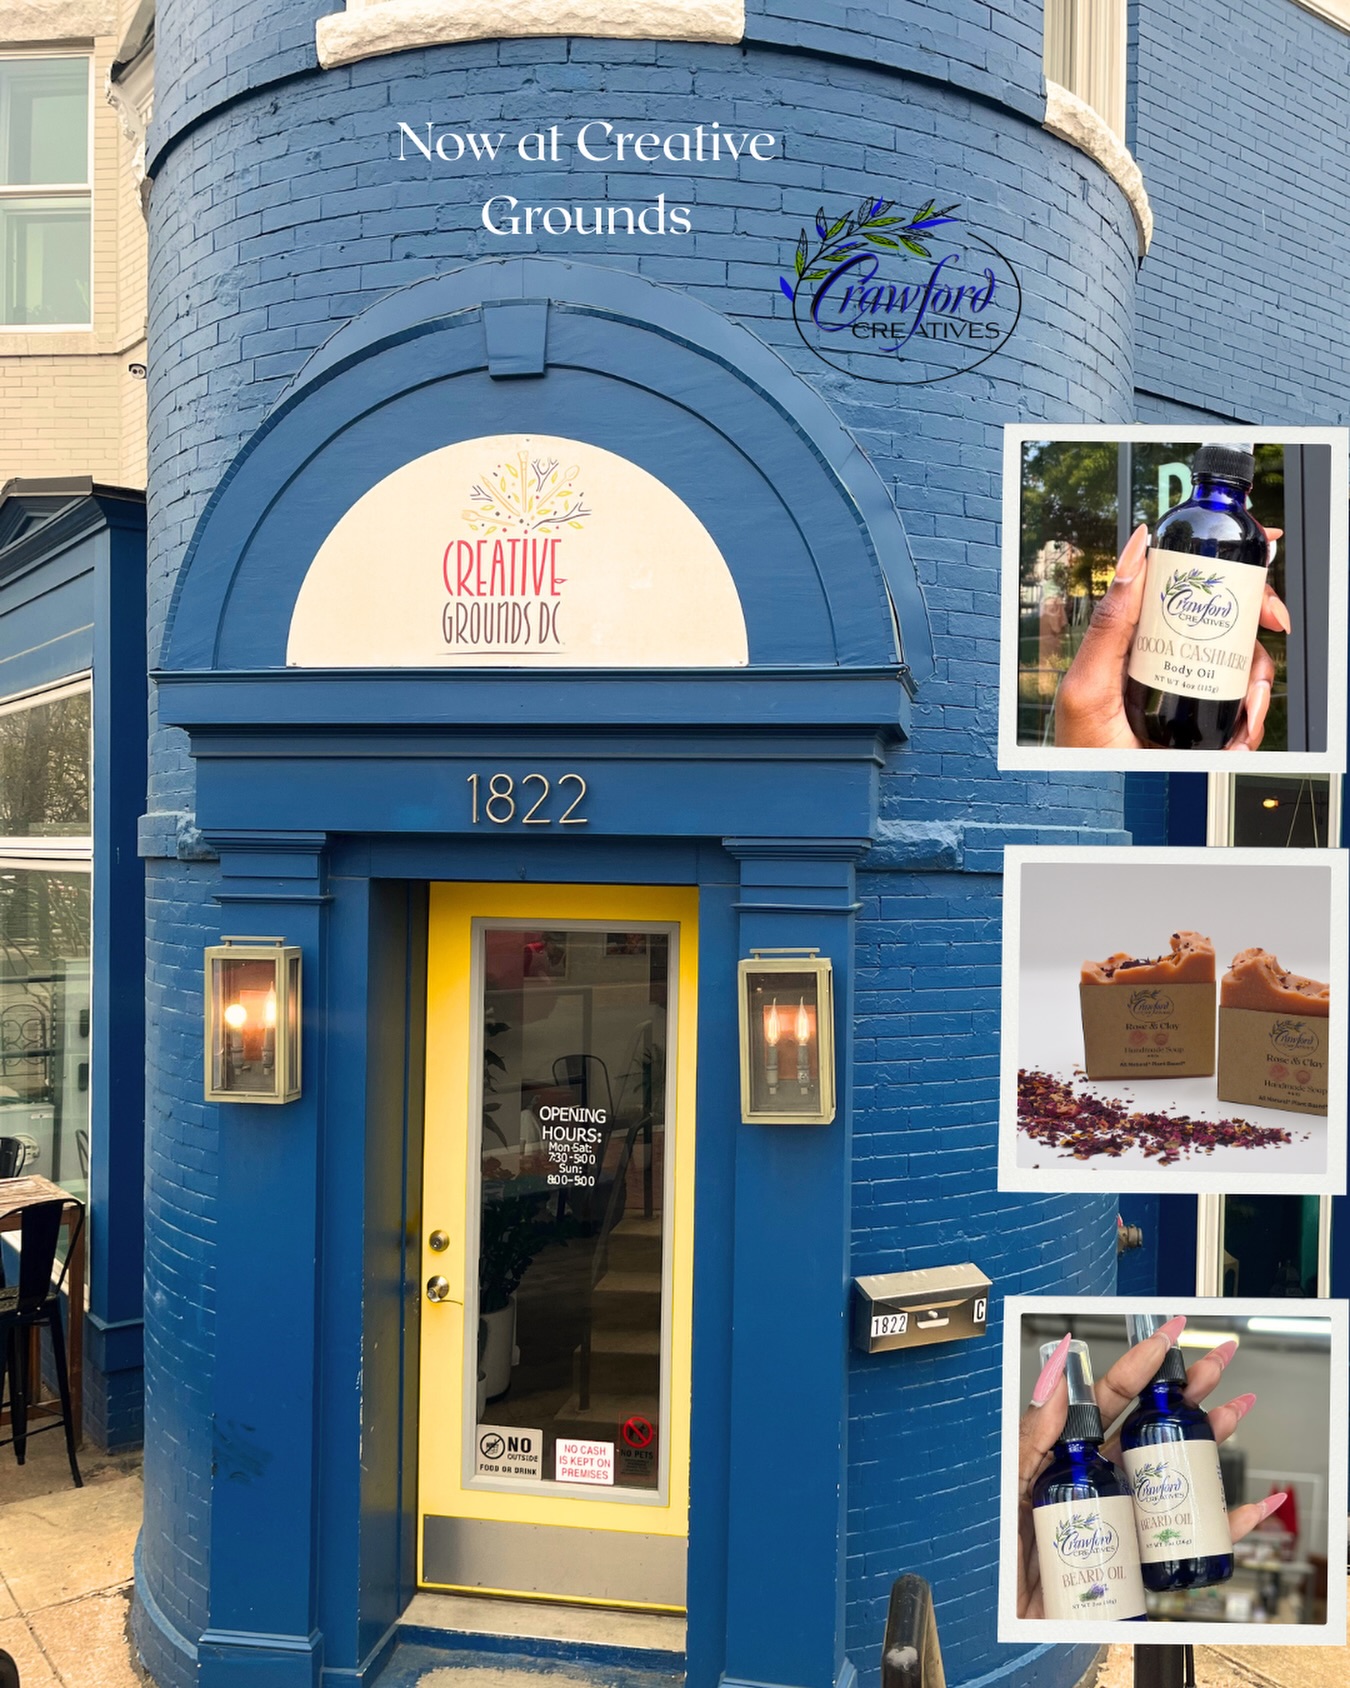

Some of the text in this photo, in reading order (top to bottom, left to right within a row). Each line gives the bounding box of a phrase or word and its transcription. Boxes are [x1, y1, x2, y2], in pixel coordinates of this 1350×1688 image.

[443, 538, 564, 597] CREATIVE
[1167, 588, 1232, 627] Crawford
[442, 601, 561, 645] GROUNDS DC
[1178, 613, 1231, 629] CREATIVES
[1136, 636, 1250, 672] COCOA CASHMERE
[1163, 661, 1215, 679] Body Oil
[1182, 681, 1196, 690] 4oz
[467, 773, 588, 823] 1822
[1160, 1022, 1179, 1030] Clay
[1267, 1053, 1324, 1068] Rose & Clay
[539, 1105, 607, 1124] OPENING
[542, 1125, 602, 1143] HOURS:
[559, 1163, 582, 1174] Sun:
[976, 1300, 984, 1320] C
[873, 1315, 906, 1335] 1822
[508, 1437, 532, 1453] NO
[564, 1444, 606, 1455] NO CASH
[507, 1453, 538, 1463] OUTSIDE
[559, 1455, 568, 1465] IS
[570, 1456, 594, 1467] KEPT
[597, 1458, 611, 1468] ON
[620, 1449, 653, 1460] NO PETS
[480, 1464, 499, 1472] FOOD
[514, 1467, 537, 1475] DRINK
[561, 1467, 608, 1480] PREMISES
[1137, 1475, 1182, 1506] Crawford
[1140, 1513, 1193, 1531] BEARD OIL
[1061, 1528, 1112, 1560] Crawford
[1073, 1546, 1116, 1557] CREATIVES
[1062, 1565, 1127, 1588] BEARD OIL
